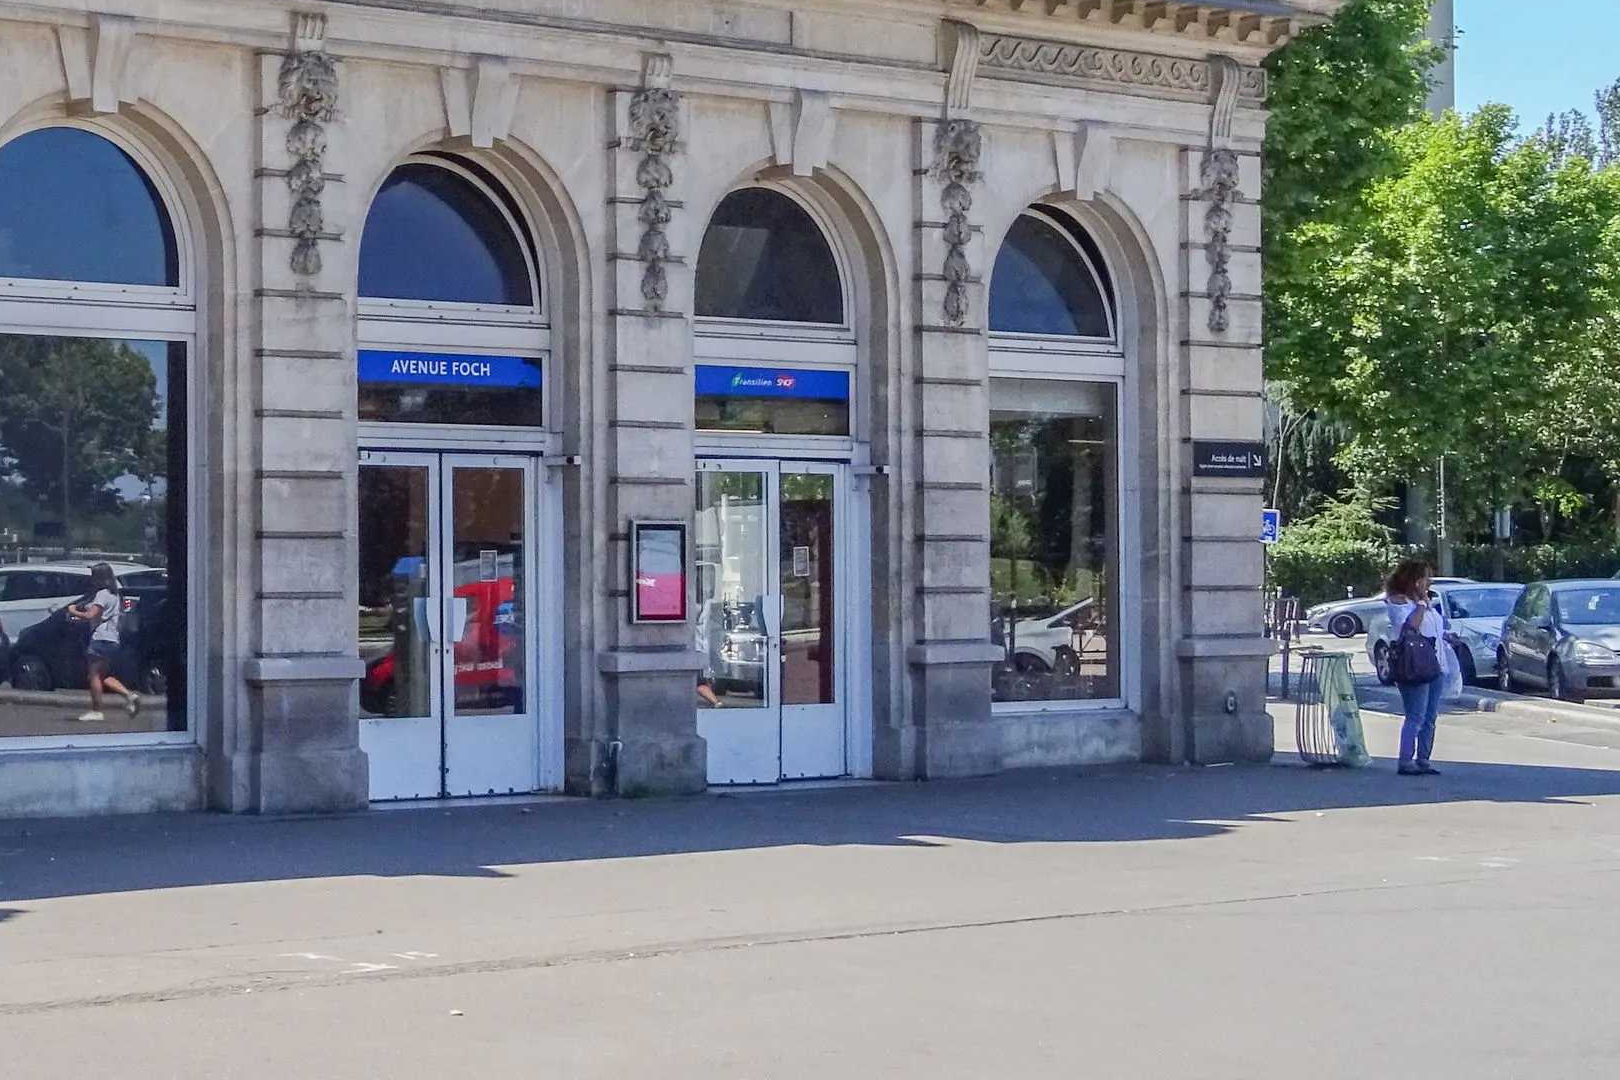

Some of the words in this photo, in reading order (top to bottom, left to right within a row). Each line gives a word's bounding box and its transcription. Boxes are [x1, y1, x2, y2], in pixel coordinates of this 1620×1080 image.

[391, 360, 447, 375] AVENUE
[452, 362, 490, 376] FOCH
[732, 376, 772, 387] Transilien
[776, 378, 794, 387] SNCF
[1227, 454, 1235, 463] de
